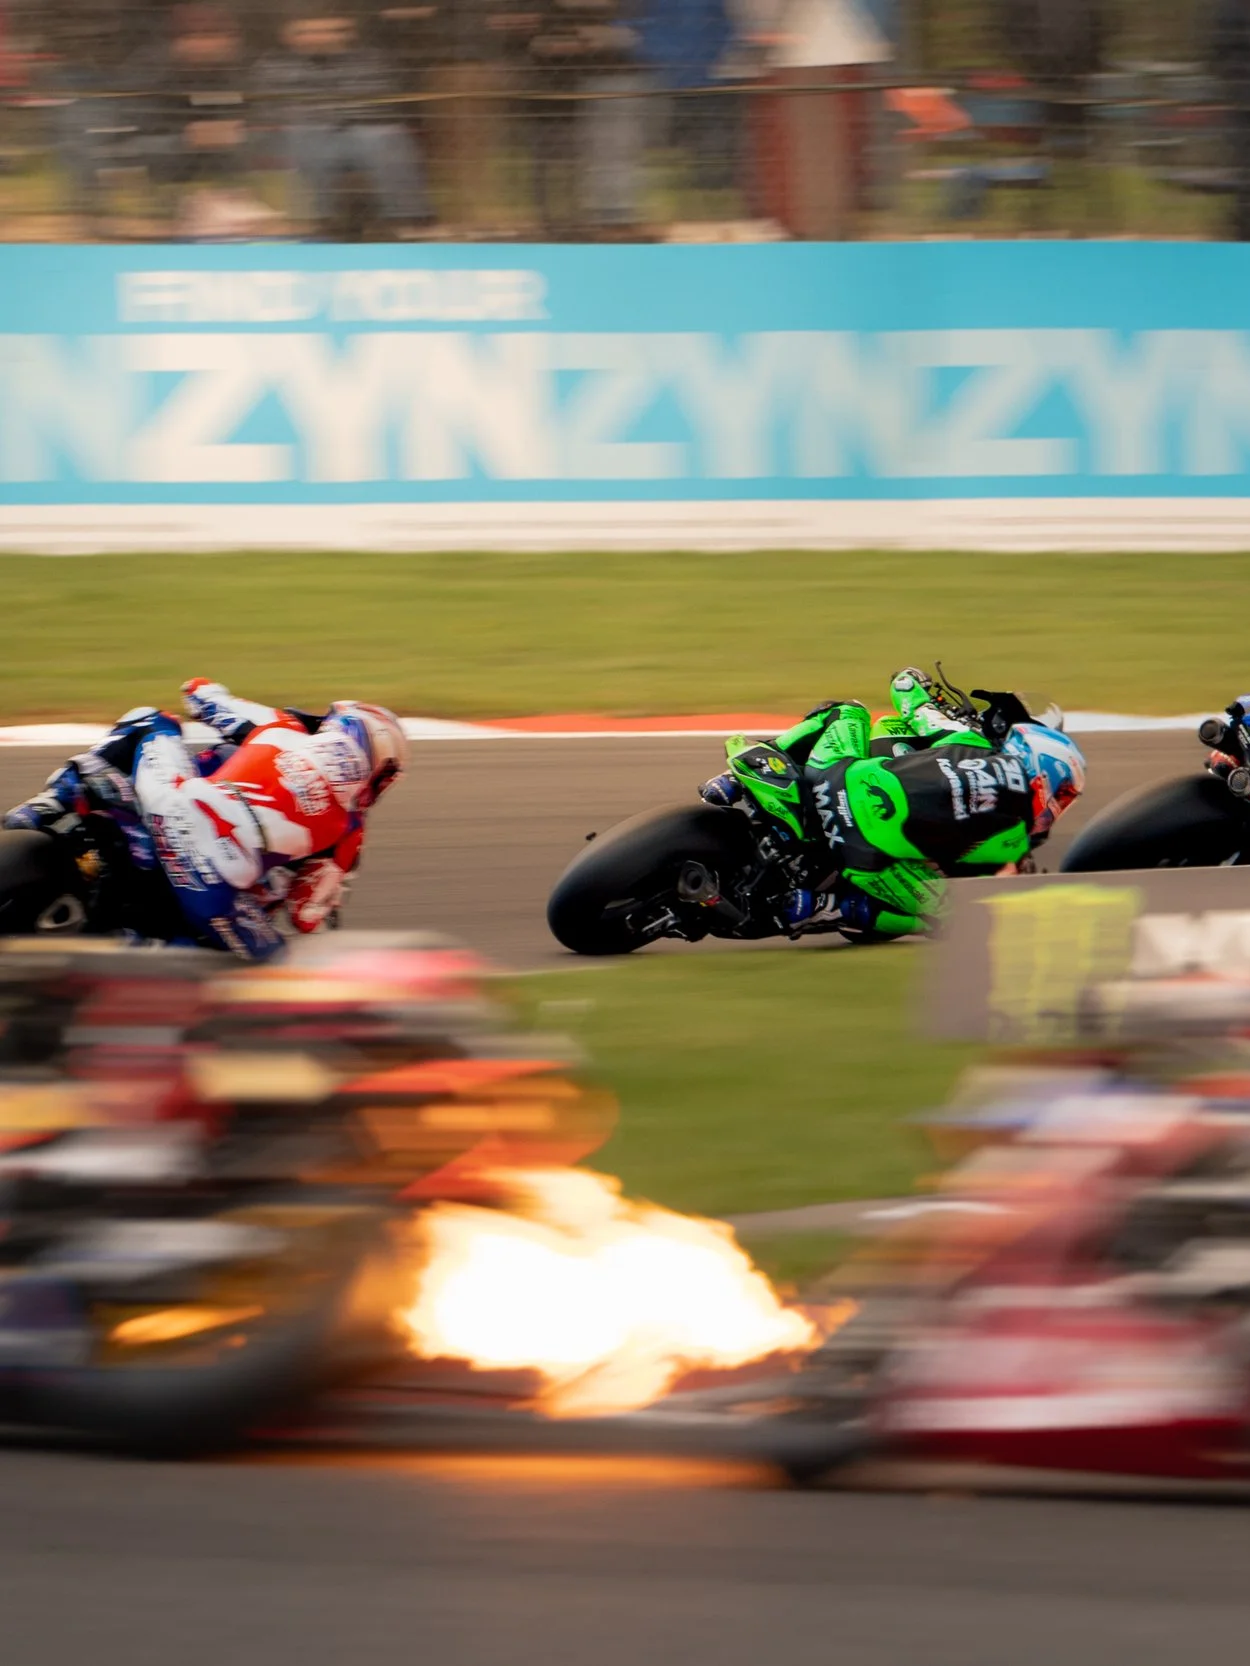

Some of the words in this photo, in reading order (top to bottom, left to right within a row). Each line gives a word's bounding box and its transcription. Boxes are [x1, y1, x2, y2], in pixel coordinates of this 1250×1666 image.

[124, 331, 562, 482] ZYN
[545, 330, 905, 480] ZYN
[812, 780, 846, 850] MAX
[995, 757, 1028, 793] 30
